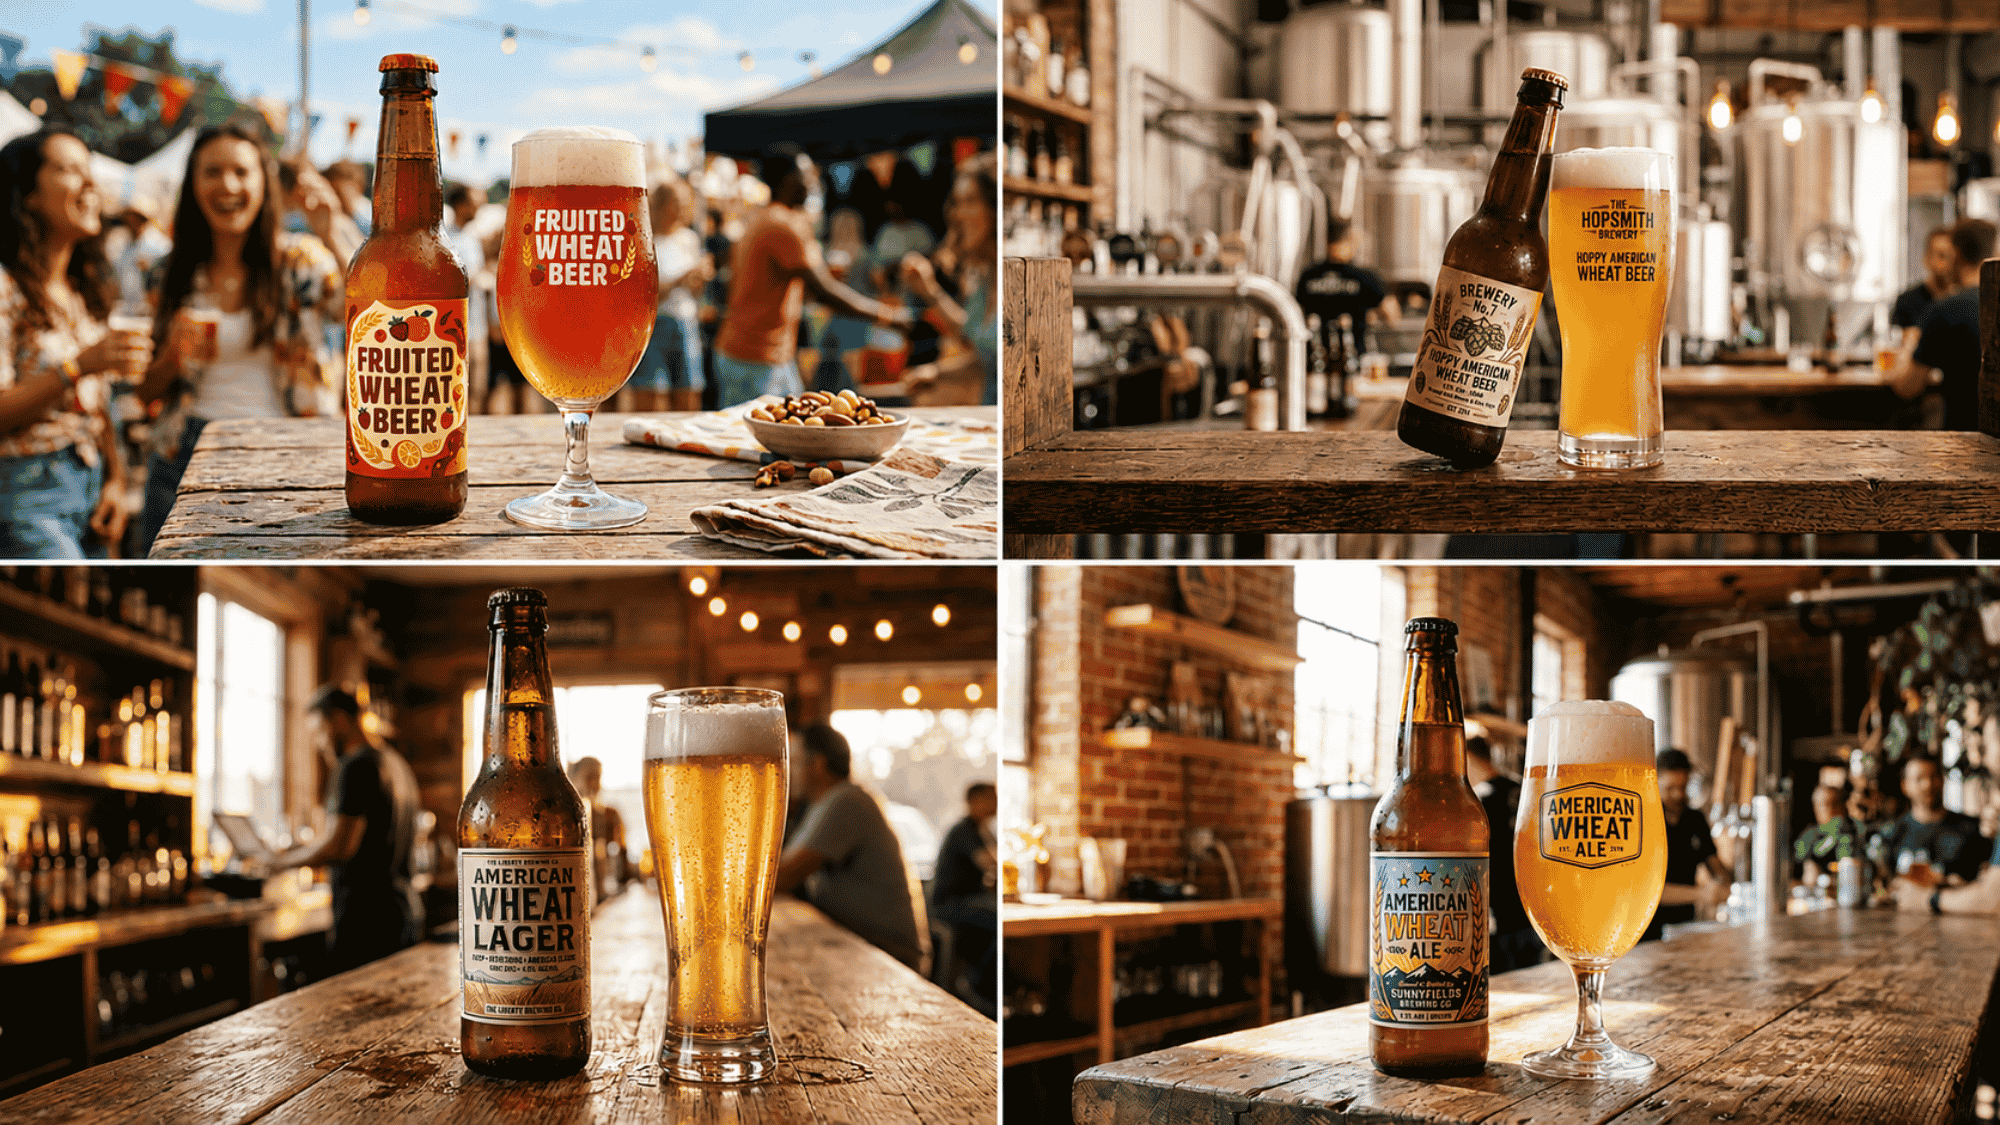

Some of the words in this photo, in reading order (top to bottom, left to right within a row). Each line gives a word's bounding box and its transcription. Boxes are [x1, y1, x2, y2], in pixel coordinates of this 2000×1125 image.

[1610, 199, 1627, 209] THE
[534, 209, 625, 232] FRUITED
[1582, 211, 1654, 228] HOPSMITH
[535, 234, 624, 260] WHEAT
[1576, 252, 1607, 263] HOPPY
[1610, 252, 1656, 263] AMERICAN
[549, 263, 608, 286] BEER
[1577, 265, 1622, 281] WHEAT
[1626, 265, 1655, 281] BEER
[1460, 283, 1517, 310] BREWERY
[357, 347, 454, 373] FRUITED
[1461, 360, 1511, 381] AMERICAN
[359, 375, 452, 405] WHEAT
[1436, 365, 1471, 385] WHEAT
[1472, 376, 1498, 392] BEER
[373, 408, 437, 434] BEER
[1548, 796, 1634, 816] AMERICAN
[1550, 816, 1632, 840] WHEAT
[1575, 842, 1606, 857] ALE
[474, 867, 573, 884] AMERICAN
[471, 886, 576, 921] WHEAT
[1384, 893, 1467, 911] AMERICAN
[474, 924, 575, 951] LAGER
[1384, 913, 1468, 942] WHEAT
[1410, 942, 1441, 959] ALE
